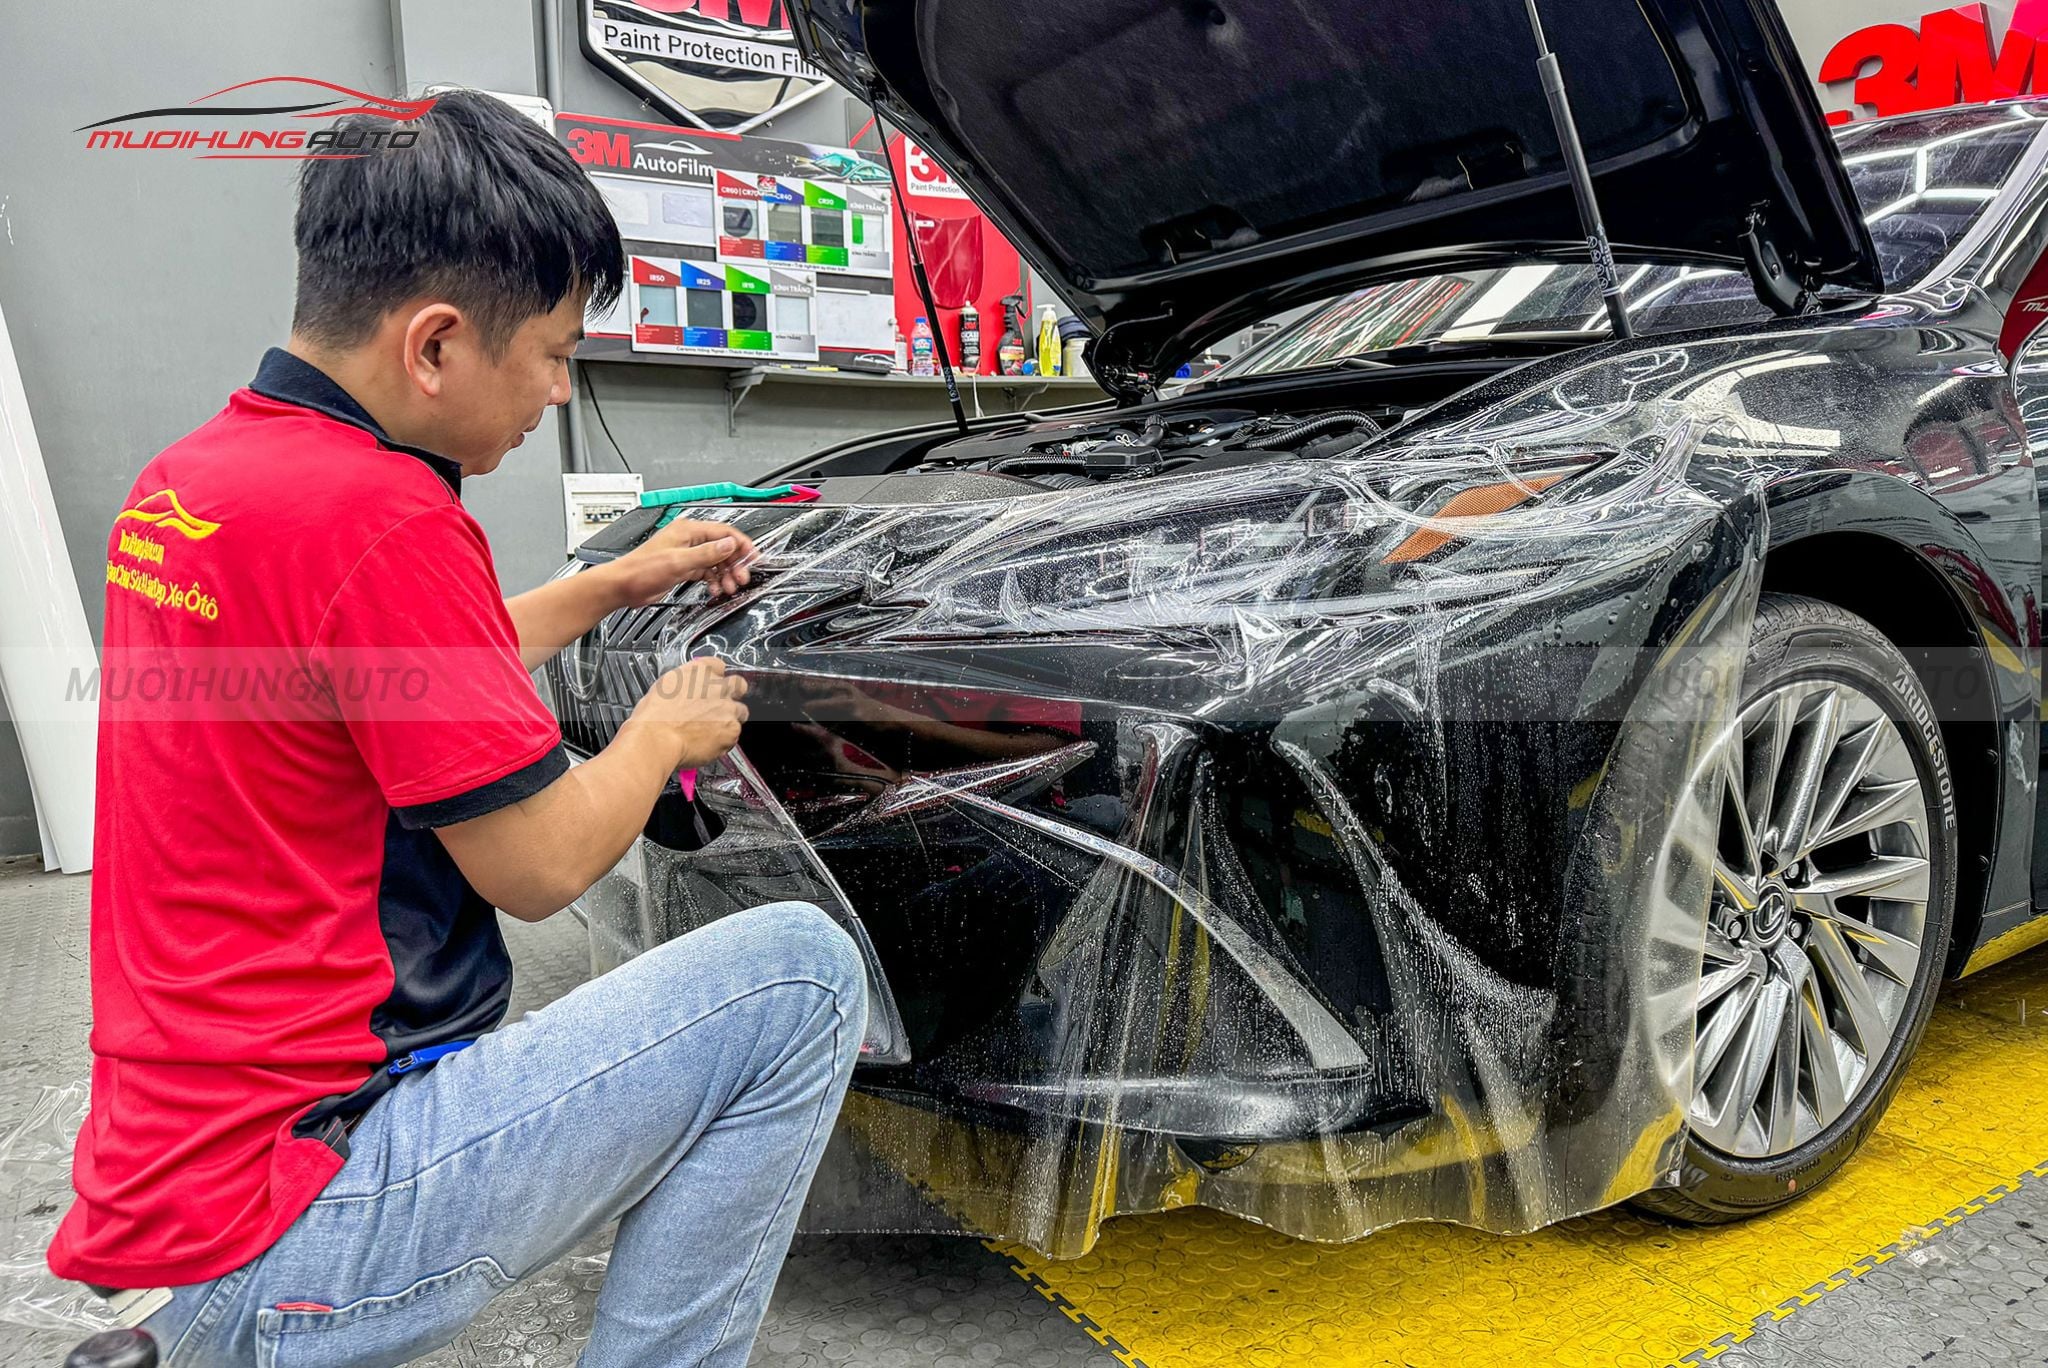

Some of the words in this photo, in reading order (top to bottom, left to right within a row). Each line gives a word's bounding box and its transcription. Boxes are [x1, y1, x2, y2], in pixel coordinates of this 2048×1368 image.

[604, 24, 661, 52] Paint
[667, 35, 776, 71] Protection
[566, 128, 631, 169] 3M
[633, 155, 714, 178] AutoFilm
[910, 183, 928, 193] Paint
[928, 184, 960, 194] Protection
[649, 273, 665, 282] IR50
[696, 278, 712, 287] IR25
[164, 581, 184, 608] Xe
[1893, 668, 1955, 830] BRIDGESTONE
